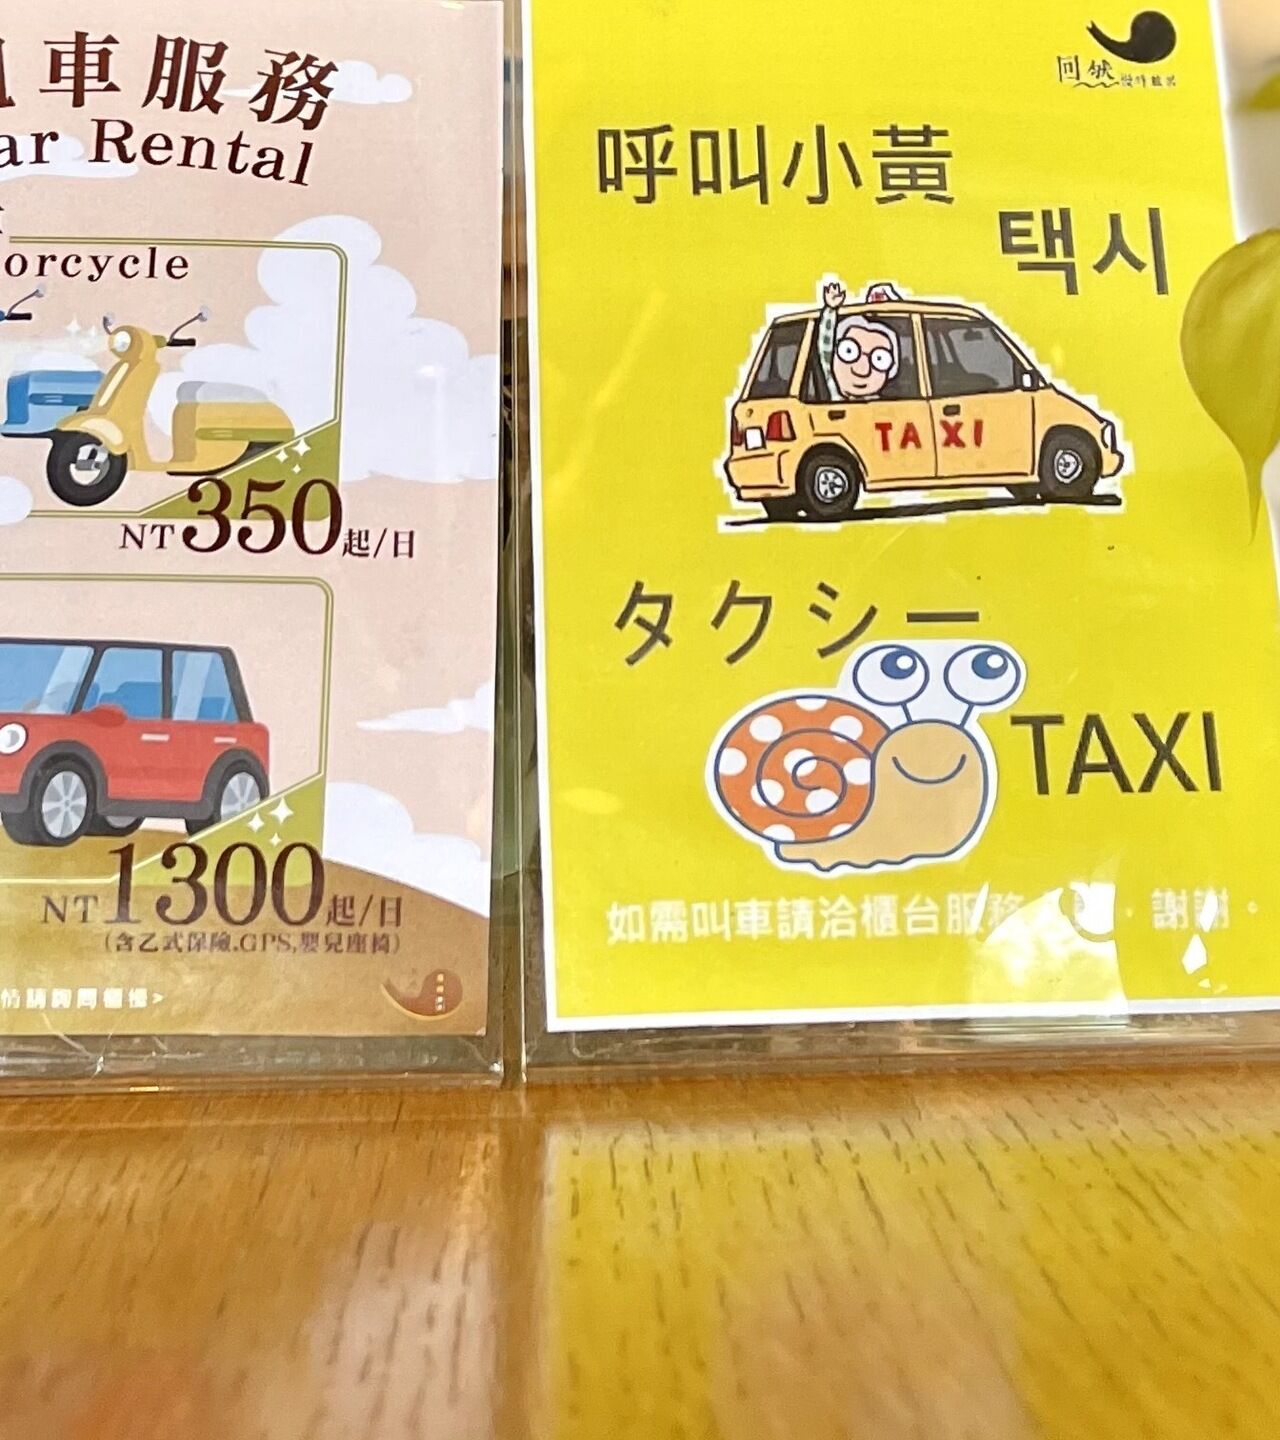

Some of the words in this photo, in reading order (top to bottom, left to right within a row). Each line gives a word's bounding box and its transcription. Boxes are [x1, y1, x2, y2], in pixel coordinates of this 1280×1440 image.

[87, 118, 315, 187] Rental
[595, 123, 957, 207] 呼叫小黃
[997, 206, 1171, 297] 택시
[874, 418, 984, 451] TAXI
[614, 579, 981, 667] タクシー
[1010, 711, 1223, 797] TAXI
